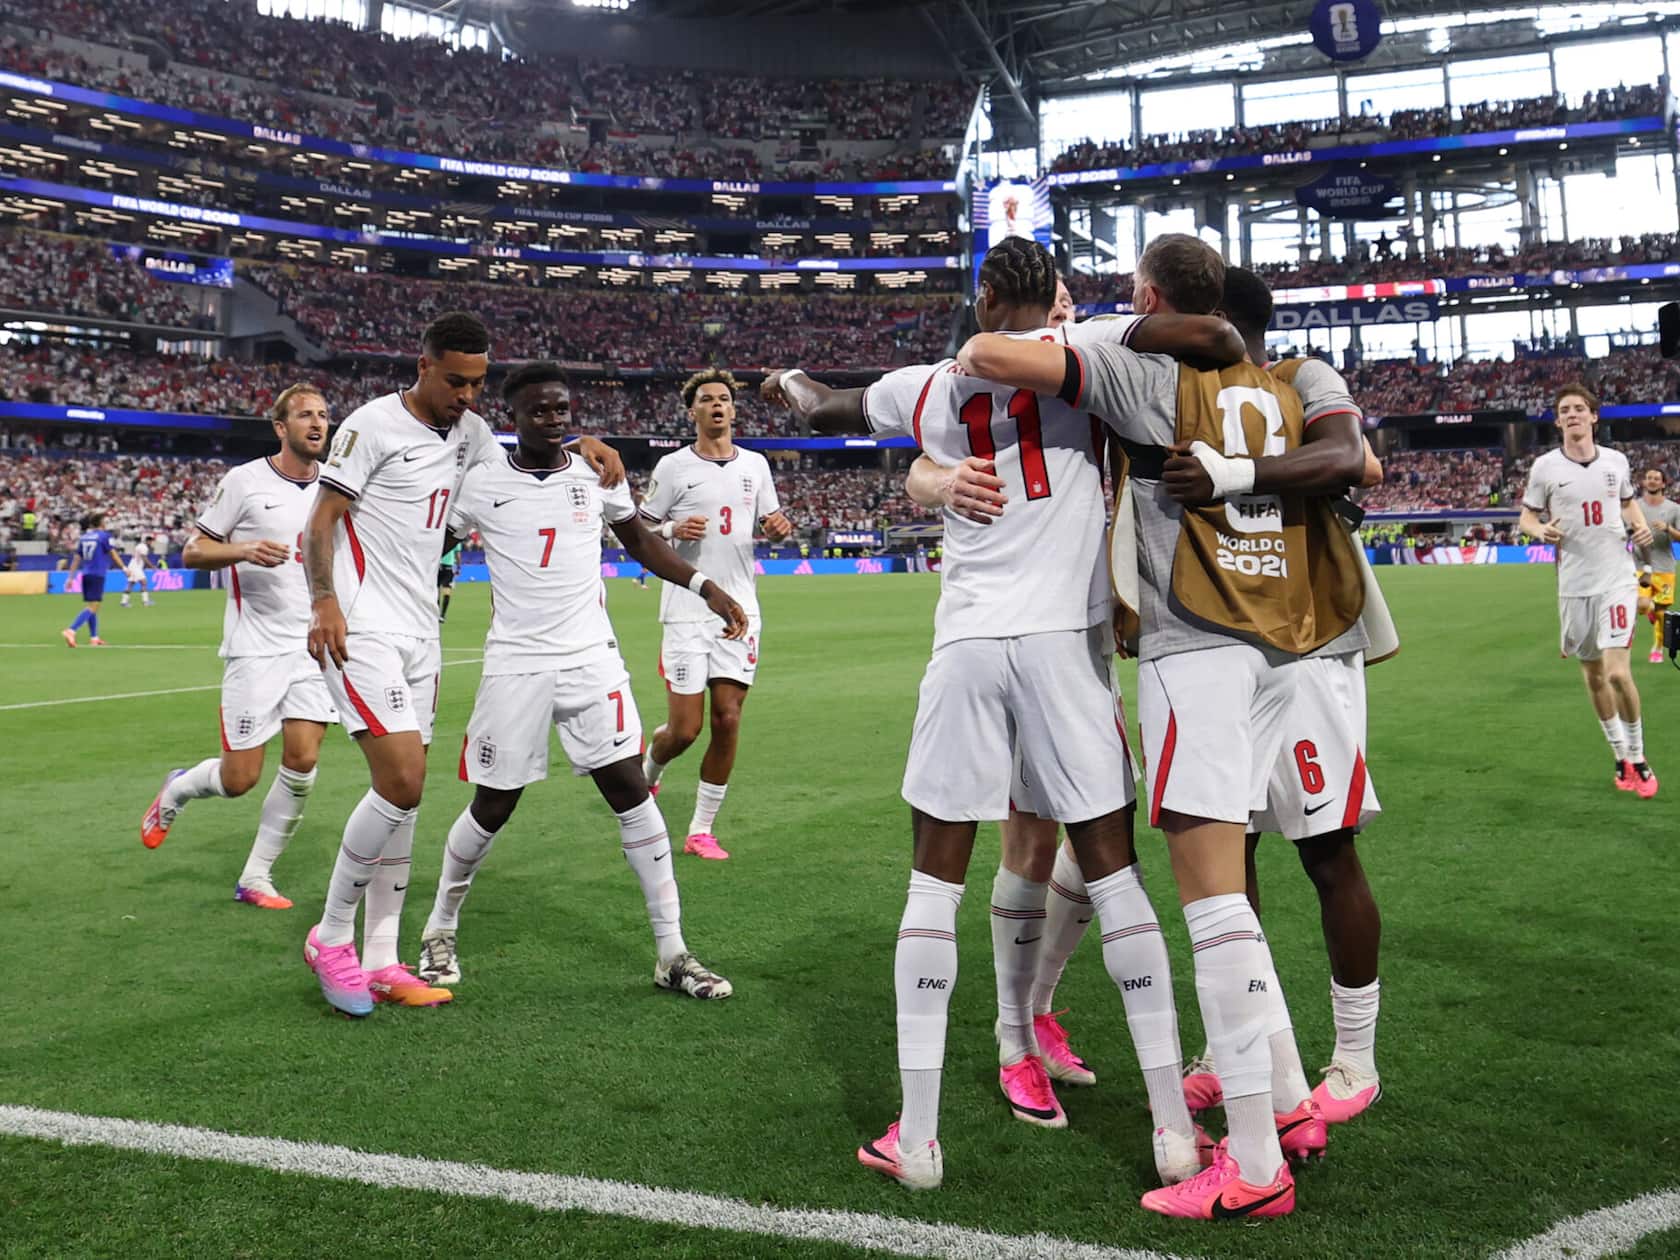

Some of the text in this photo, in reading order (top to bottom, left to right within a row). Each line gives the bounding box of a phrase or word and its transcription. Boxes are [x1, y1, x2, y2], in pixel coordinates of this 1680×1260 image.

[253, 126, 301, 145] DALLAS
[1263, 151, 1312, 165] DALLAS
[440, 157, 464, 171] FIFA
[464, 161, 506, 176] WORLD
[506, 166, 530, 179] CUP
[713, 181, 760, 193] DALLAS
[1057, 172, 1079, 184] CUP
[1335, 175, 1361, 186] FIFA
[319, 183, 371, 198] DALLAS
[1316, 184, 1384, 198] WORLD CUP
[112, 195, 138, 211] FIFA
[138, 199, 179, 216] WORLD
[179, 206, 202, 220] CUP
[514, 207, 532, 217] FIFA
[533, 209, 564, 219] WORLD
[564, 210, 582, 220] CUP
[756, 221, 810, 229] DALLAS
[145, 257, 196, 275] DALLAS
[1468, 276, 1514, 288] DALLAS
[1275, 302, 1430, 329] DALLAS
[959, 388, 1051, 508] 11
[426, 488, 450, 529] 17
[1239, 502, 1279, 519] FIFA
[1582, 500, 1603, 527] 18
[719, 506, 732, 535] 3
[538, 528, 556, 567] 7
[834, 534, 874, 544] DALLAS
[1216, 531, 1272, 553] WORLD
[81, 541, 97, 560] 17
[1526, 545, 1555, 563] Thi
[855, 559, 883, 574] This
[152, 568, 184, 590] This
[1609, 604, 1627, 630] 18
[607, 690, 624, 733] 7
[1293, 739, 1325, 795] 6
[917, 977, 948, 990] ENG
[1123, 975, 1152, 991] ENG
[1248, 979, 1267, 993] EN
